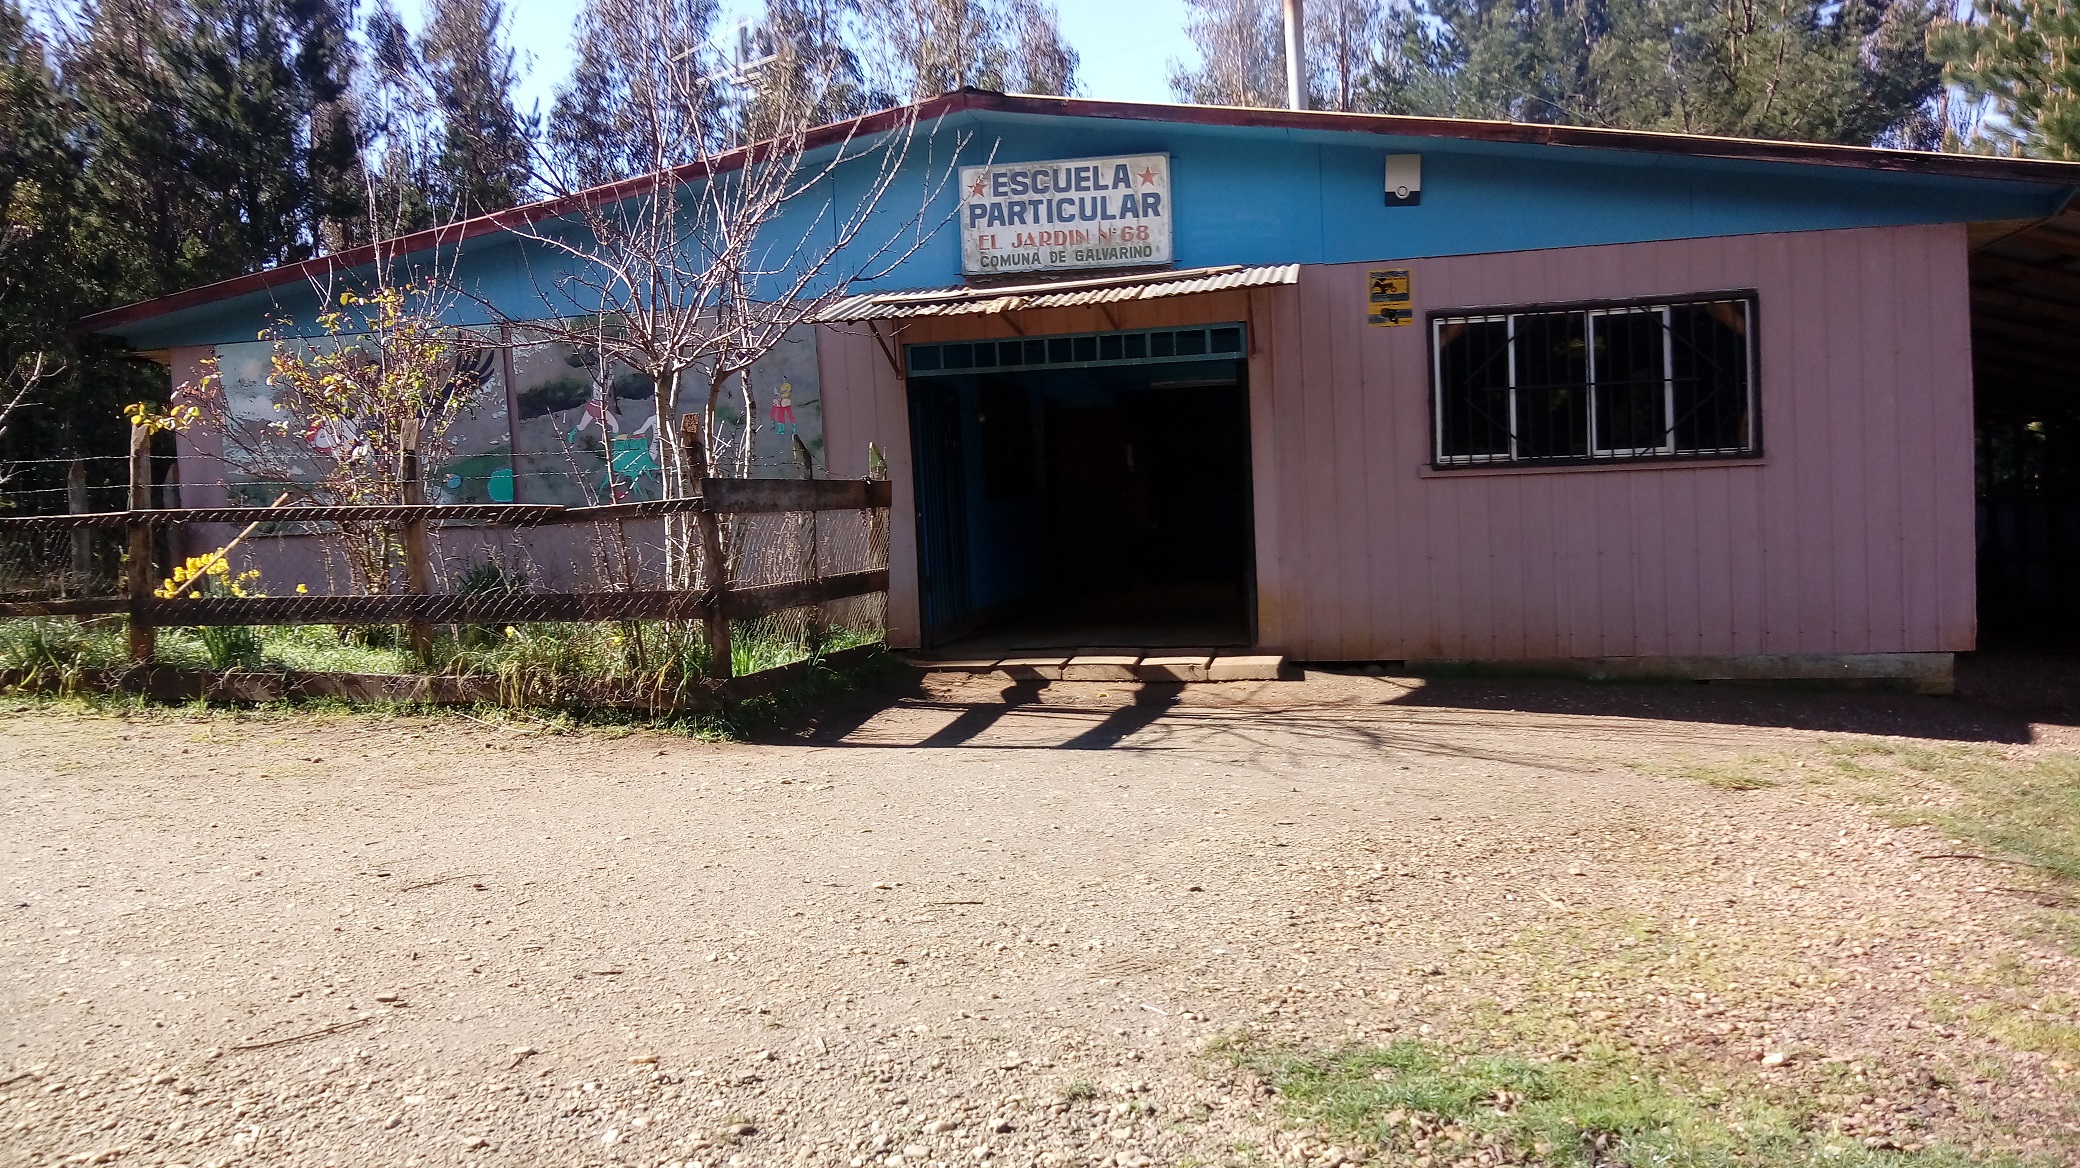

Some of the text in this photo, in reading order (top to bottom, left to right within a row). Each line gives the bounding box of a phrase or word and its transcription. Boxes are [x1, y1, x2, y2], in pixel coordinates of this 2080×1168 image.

[992, 164, 1131, 197] ESCUELA
[969, 192, 1161, 228] PARTICULAR
[978, 234, 1002, 250] EL
[1012, 228, 1089, 249] JARDIN
[980, 245, 1152, 268] COMUNA DE GALVARINO
